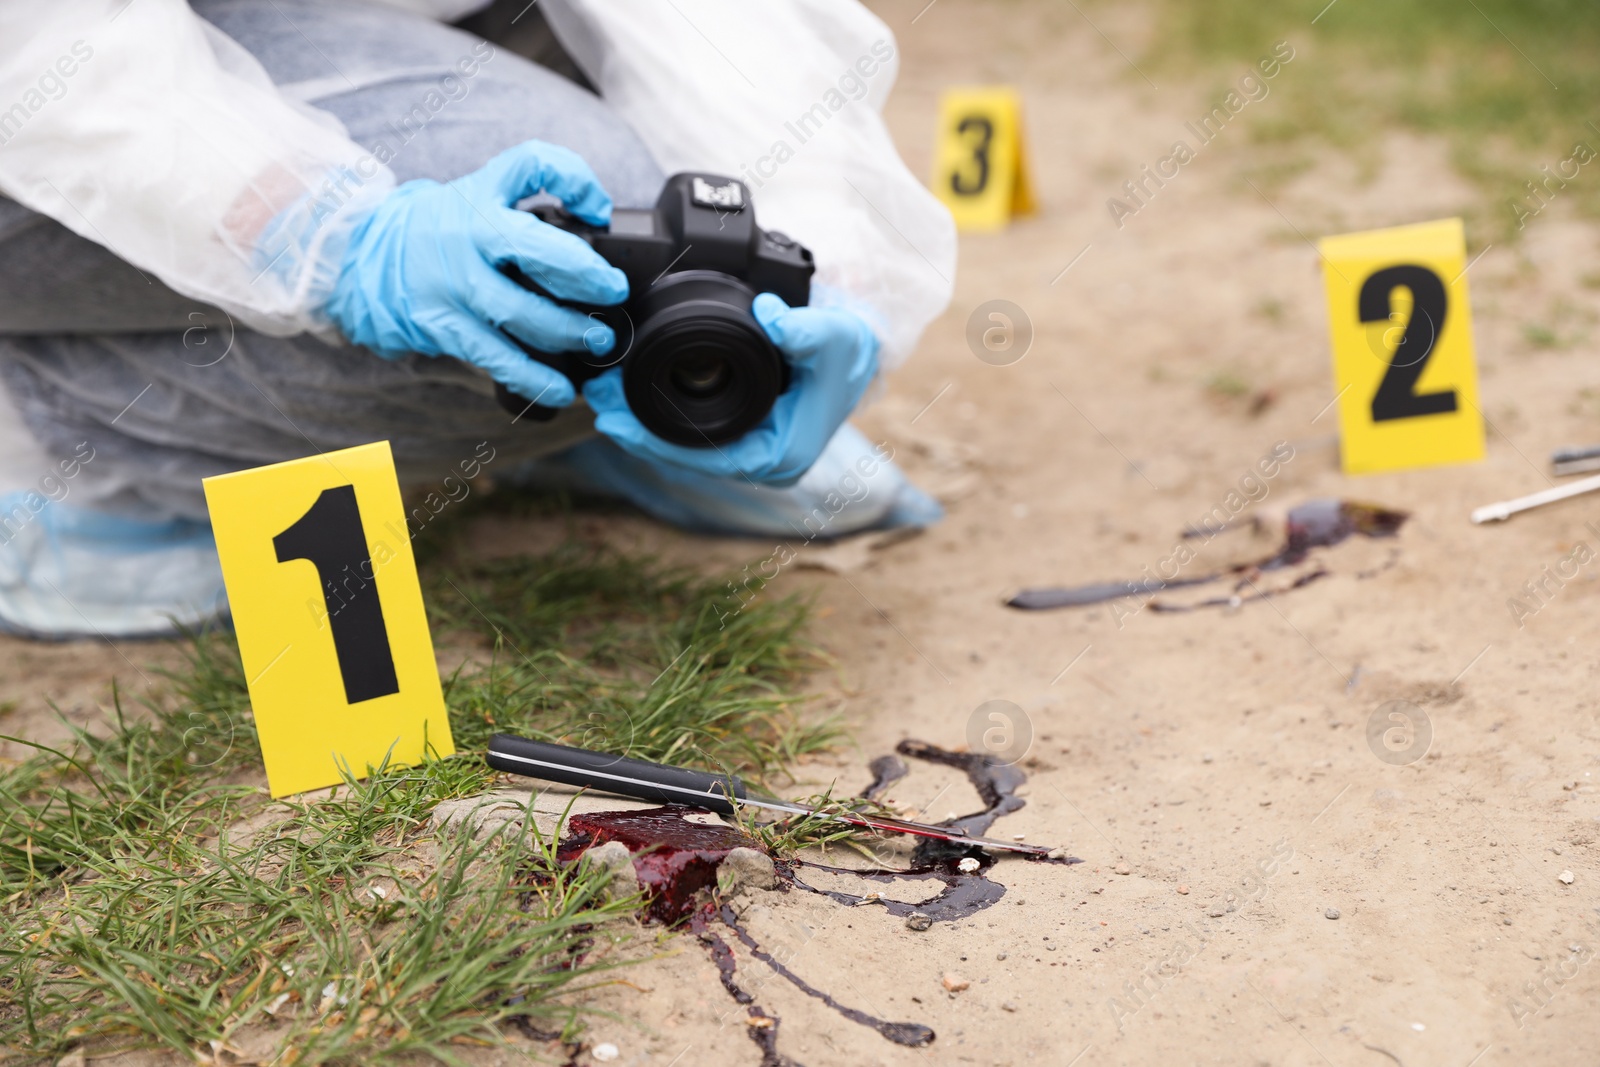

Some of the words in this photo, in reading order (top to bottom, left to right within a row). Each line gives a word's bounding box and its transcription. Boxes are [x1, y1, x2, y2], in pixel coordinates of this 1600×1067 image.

[951, 113, 996, 199] 3
[1358, 263, 1458, 423] 2
[272, 483, 400, 705] 1
